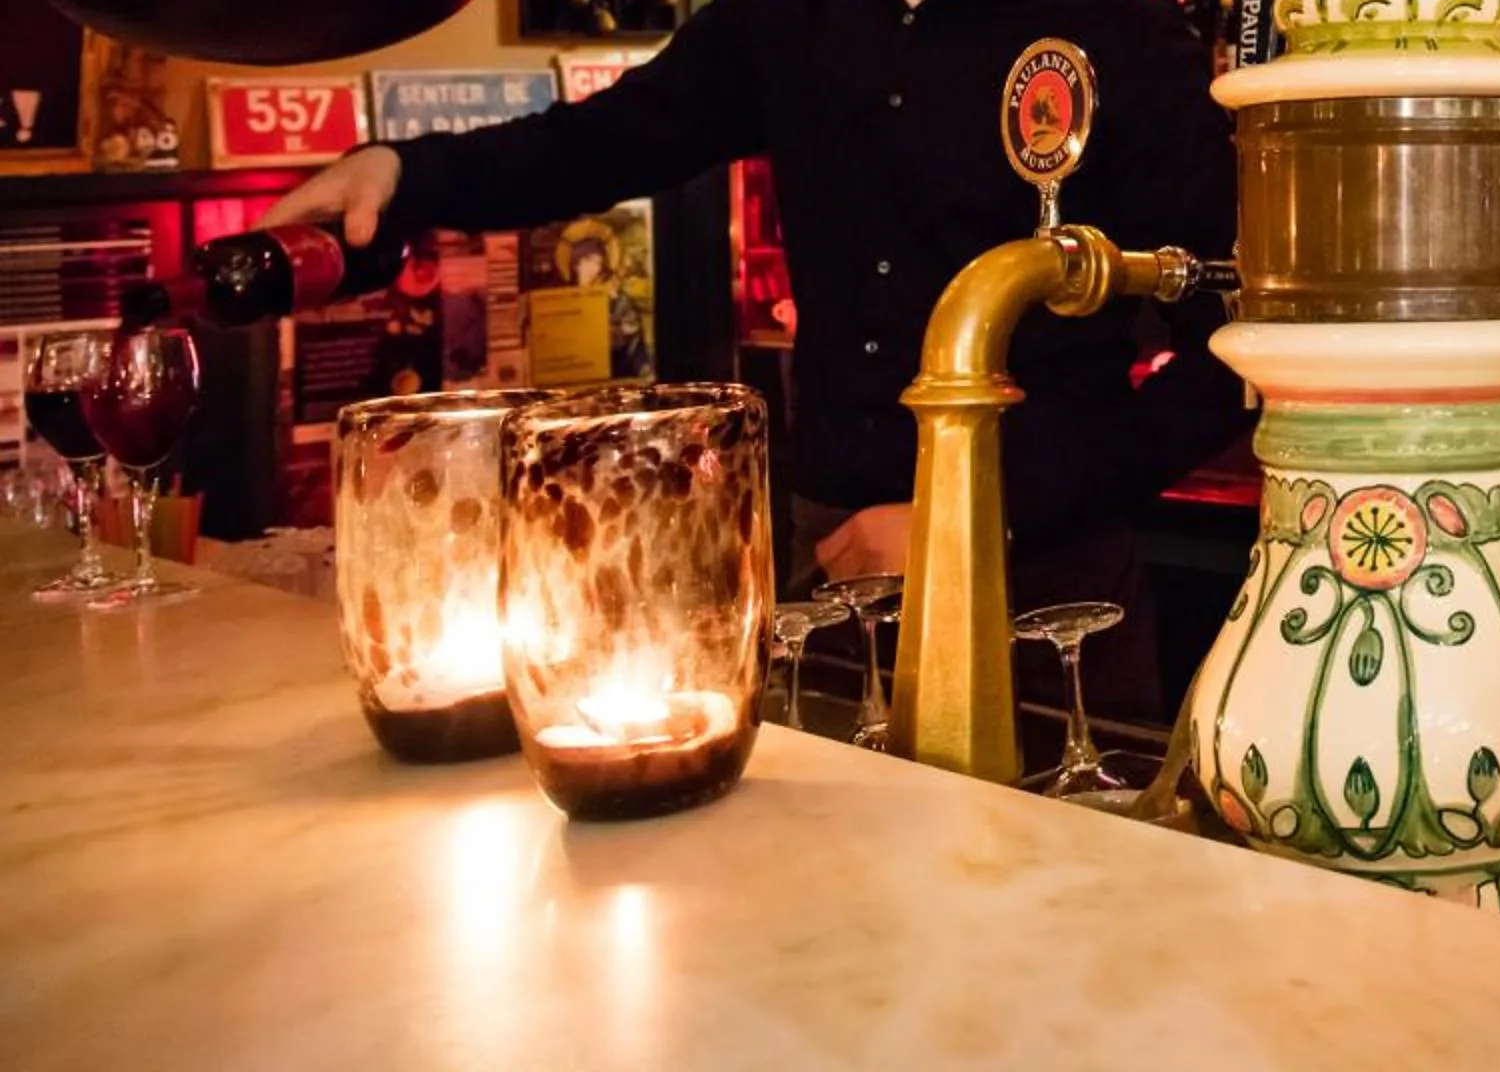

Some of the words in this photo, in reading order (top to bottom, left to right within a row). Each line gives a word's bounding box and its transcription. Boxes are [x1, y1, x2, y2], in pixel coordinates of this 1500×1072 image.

[398, 82, 486, 105] SENTIER
[1010, 52, 1078, 108] PAULANER
[246, 89, 334, 134] 557
